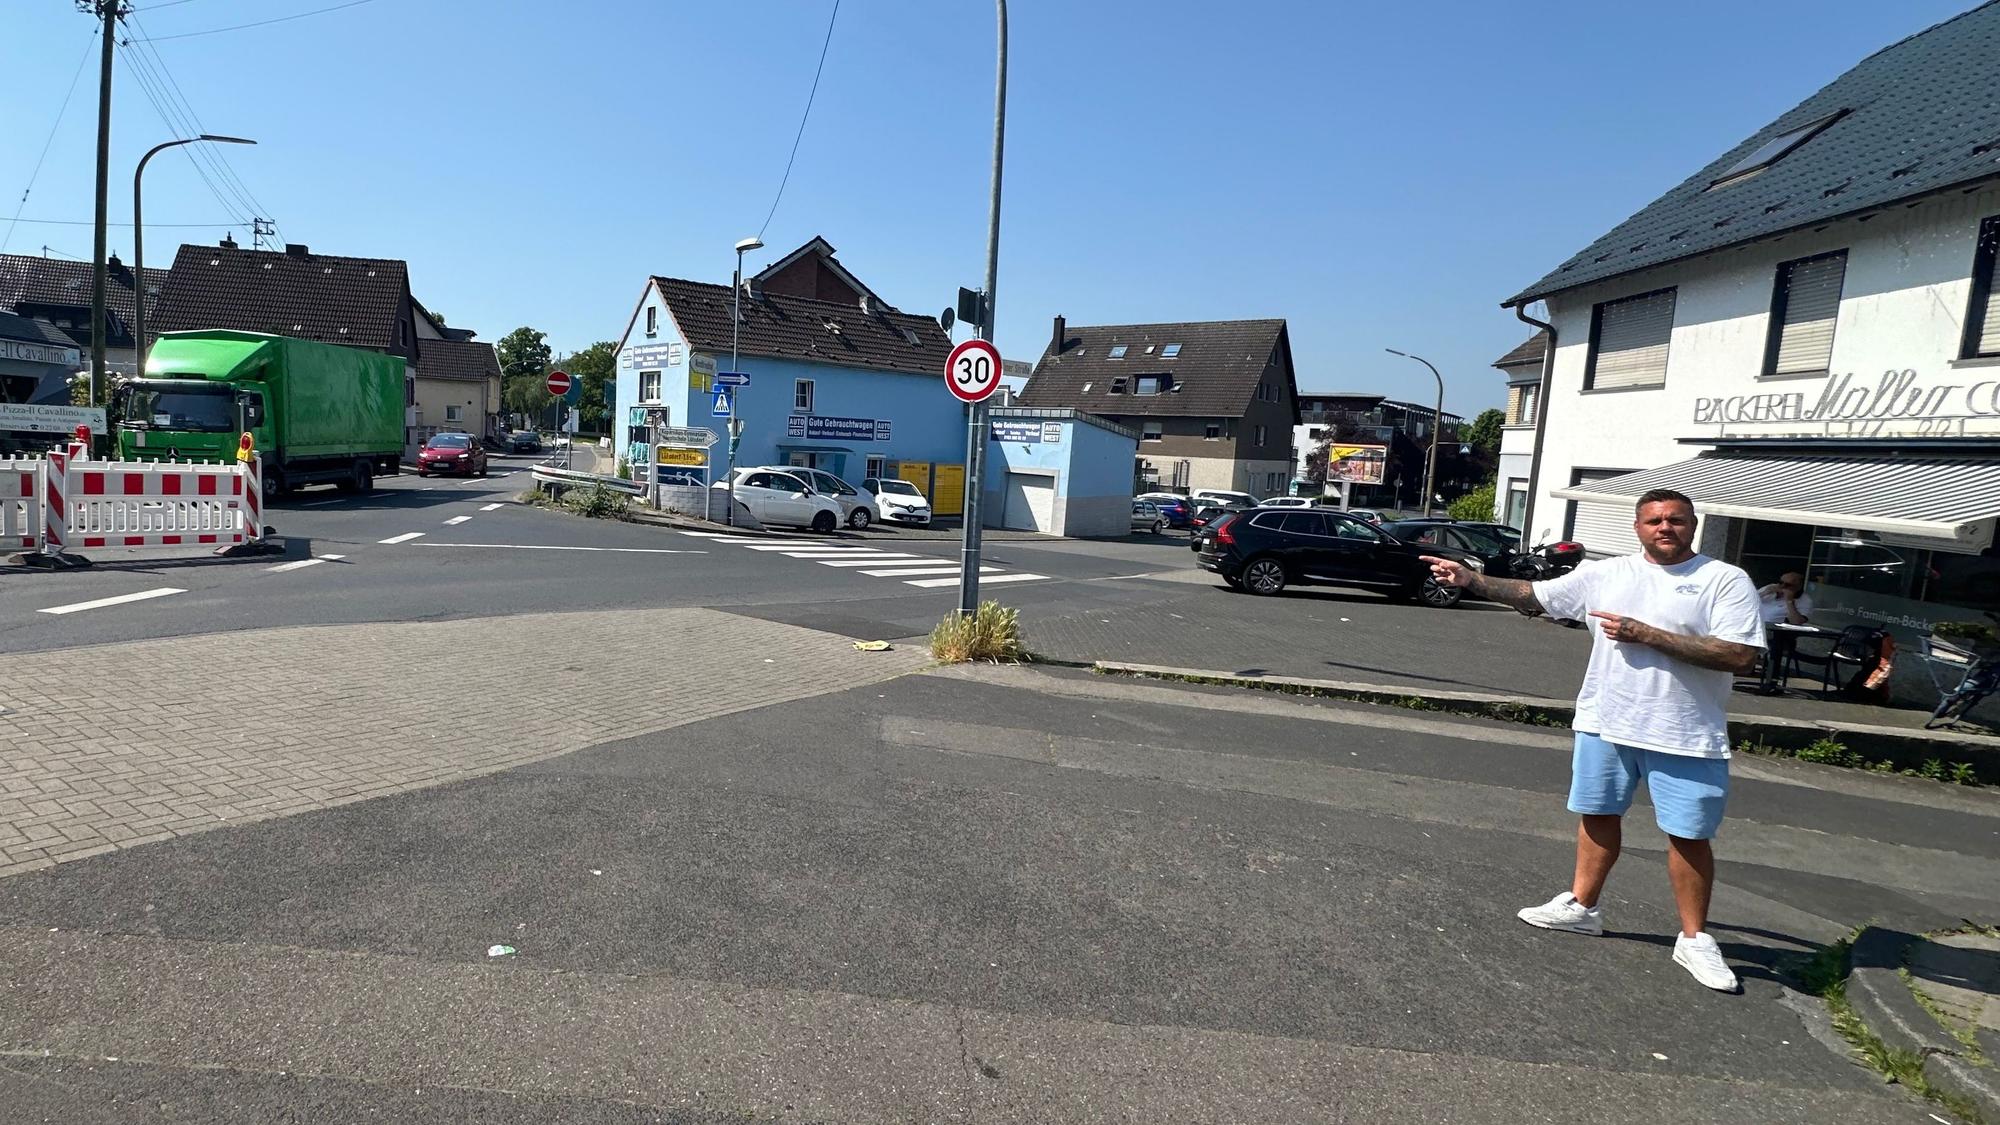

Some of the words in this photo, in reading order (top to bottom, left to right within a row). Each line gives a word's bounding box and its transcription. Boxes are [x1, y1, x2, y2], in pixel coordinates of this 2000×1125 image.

[0, 341, 13, 358] -Il
[16, 343, 66, 363] Cavallino
[957, 356, 990, 384] 30
[3, 405, 36, 415] Pizza-Il
[1694, 393, 1804, 422] BÄCKEREI
[789, 418, 805, 426] AUTO
[809, 417, 823, 427] Gute
[824, 418, 873, 430] Gebrauchtwagen
[878, 422, 891, 430] AUTO
[1045, 424, 1061, 432] AUTO
[1857, 606, 1936, 632] Familien-Bäcke
